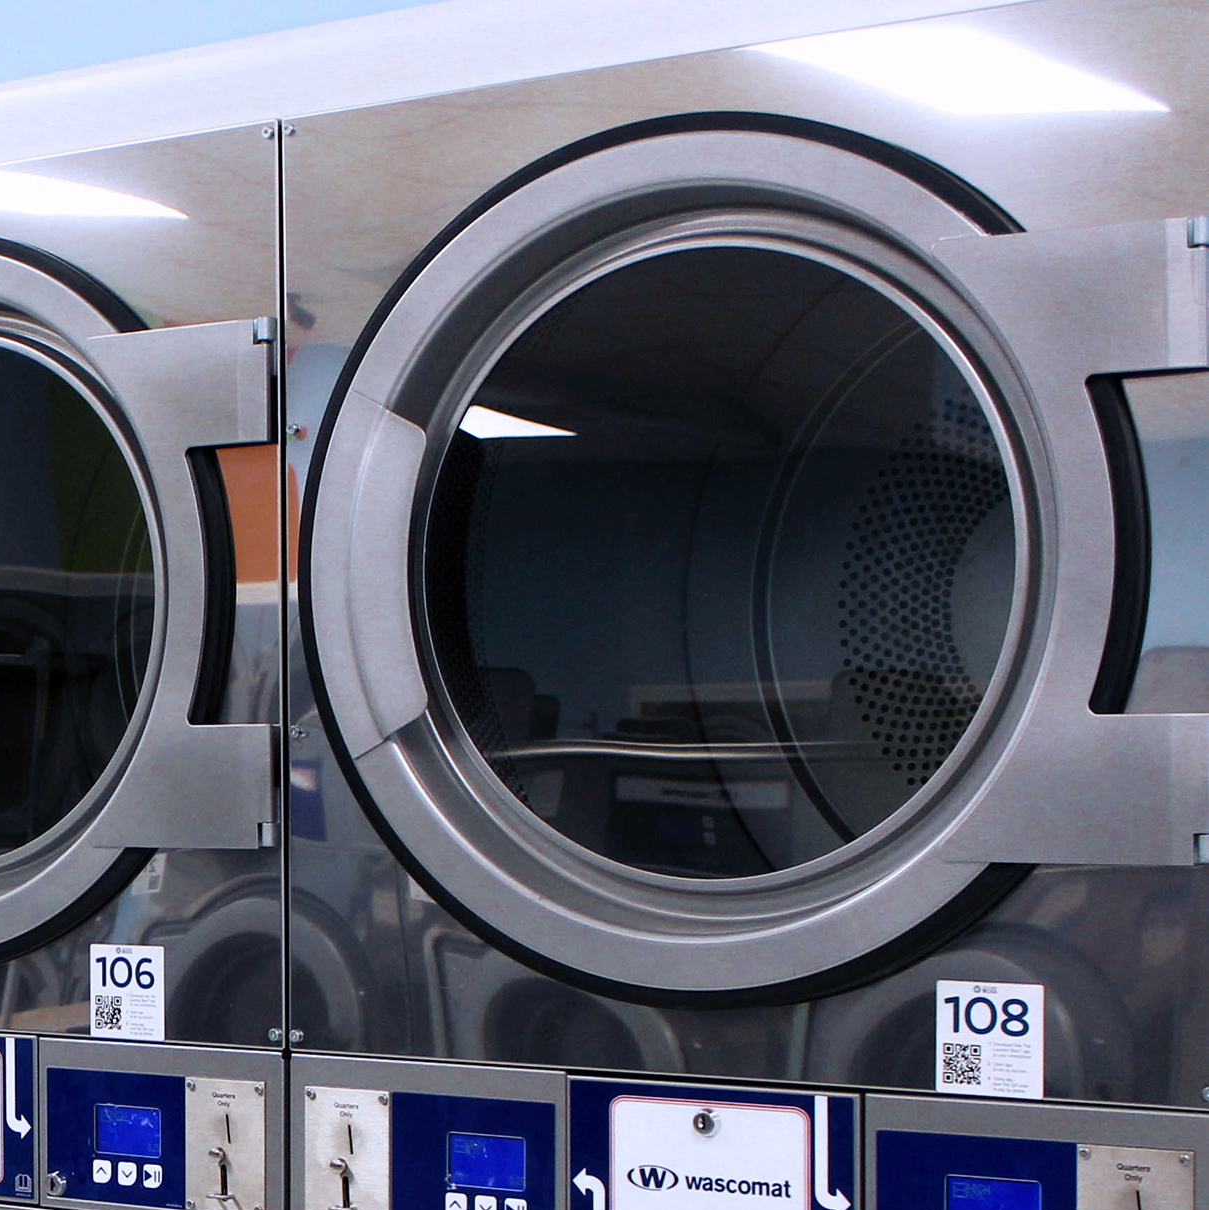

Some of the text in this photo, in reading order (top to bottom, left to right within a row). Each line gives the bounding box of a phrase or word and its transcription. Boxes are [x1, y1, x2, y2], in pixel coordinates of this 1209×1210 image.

[95, 956, 155, 990] 106
[944, 995, 1030, 1037] 108
[211, 1091, 236, 1099] Quarters
[217, 1100, 230, 1108] Only
[333, 1101, 360, 1110] Quarters
[339, 1110, 353, 1119] Only
[1116, 1162, 1152, 1172] Quarters
[1124, 1173, 1143, 1183] Only
[684, 1174, 792, 1199] wascomat
